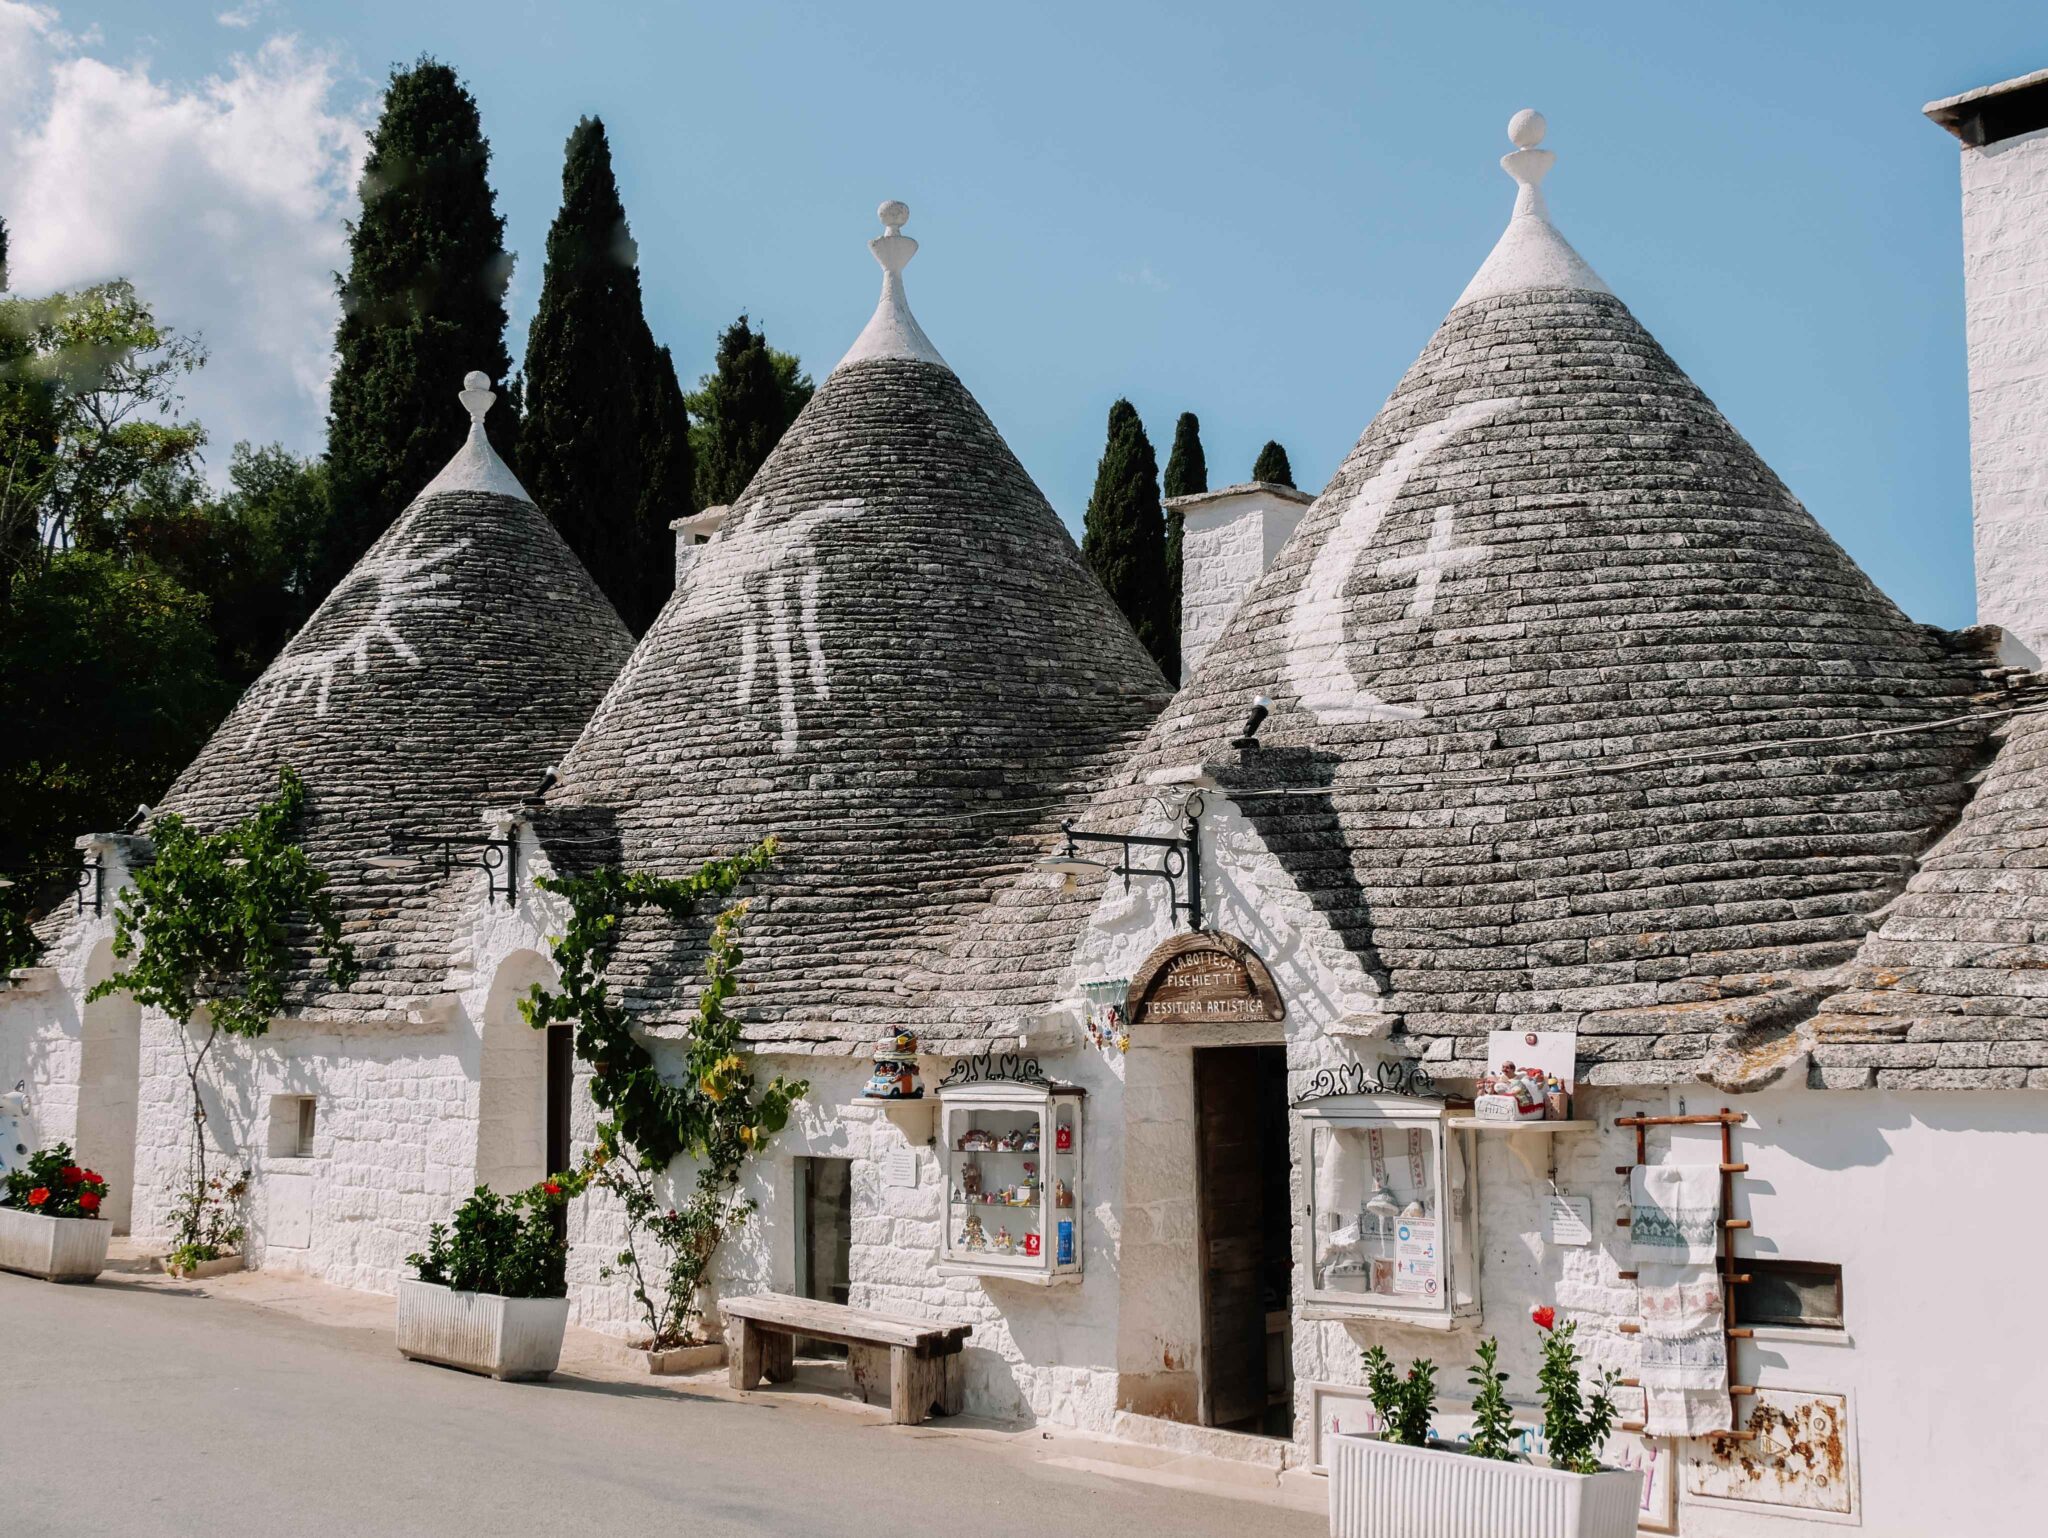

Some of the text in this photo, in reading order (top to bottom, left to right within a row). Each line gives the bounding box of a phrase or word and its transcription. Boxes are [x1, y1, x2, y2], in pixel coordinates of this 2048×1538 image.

[1167, 973, 1237, 987] FISCHIETTI
[1145, 999, 1263, 1014] TESSITURA ARTISTICA
